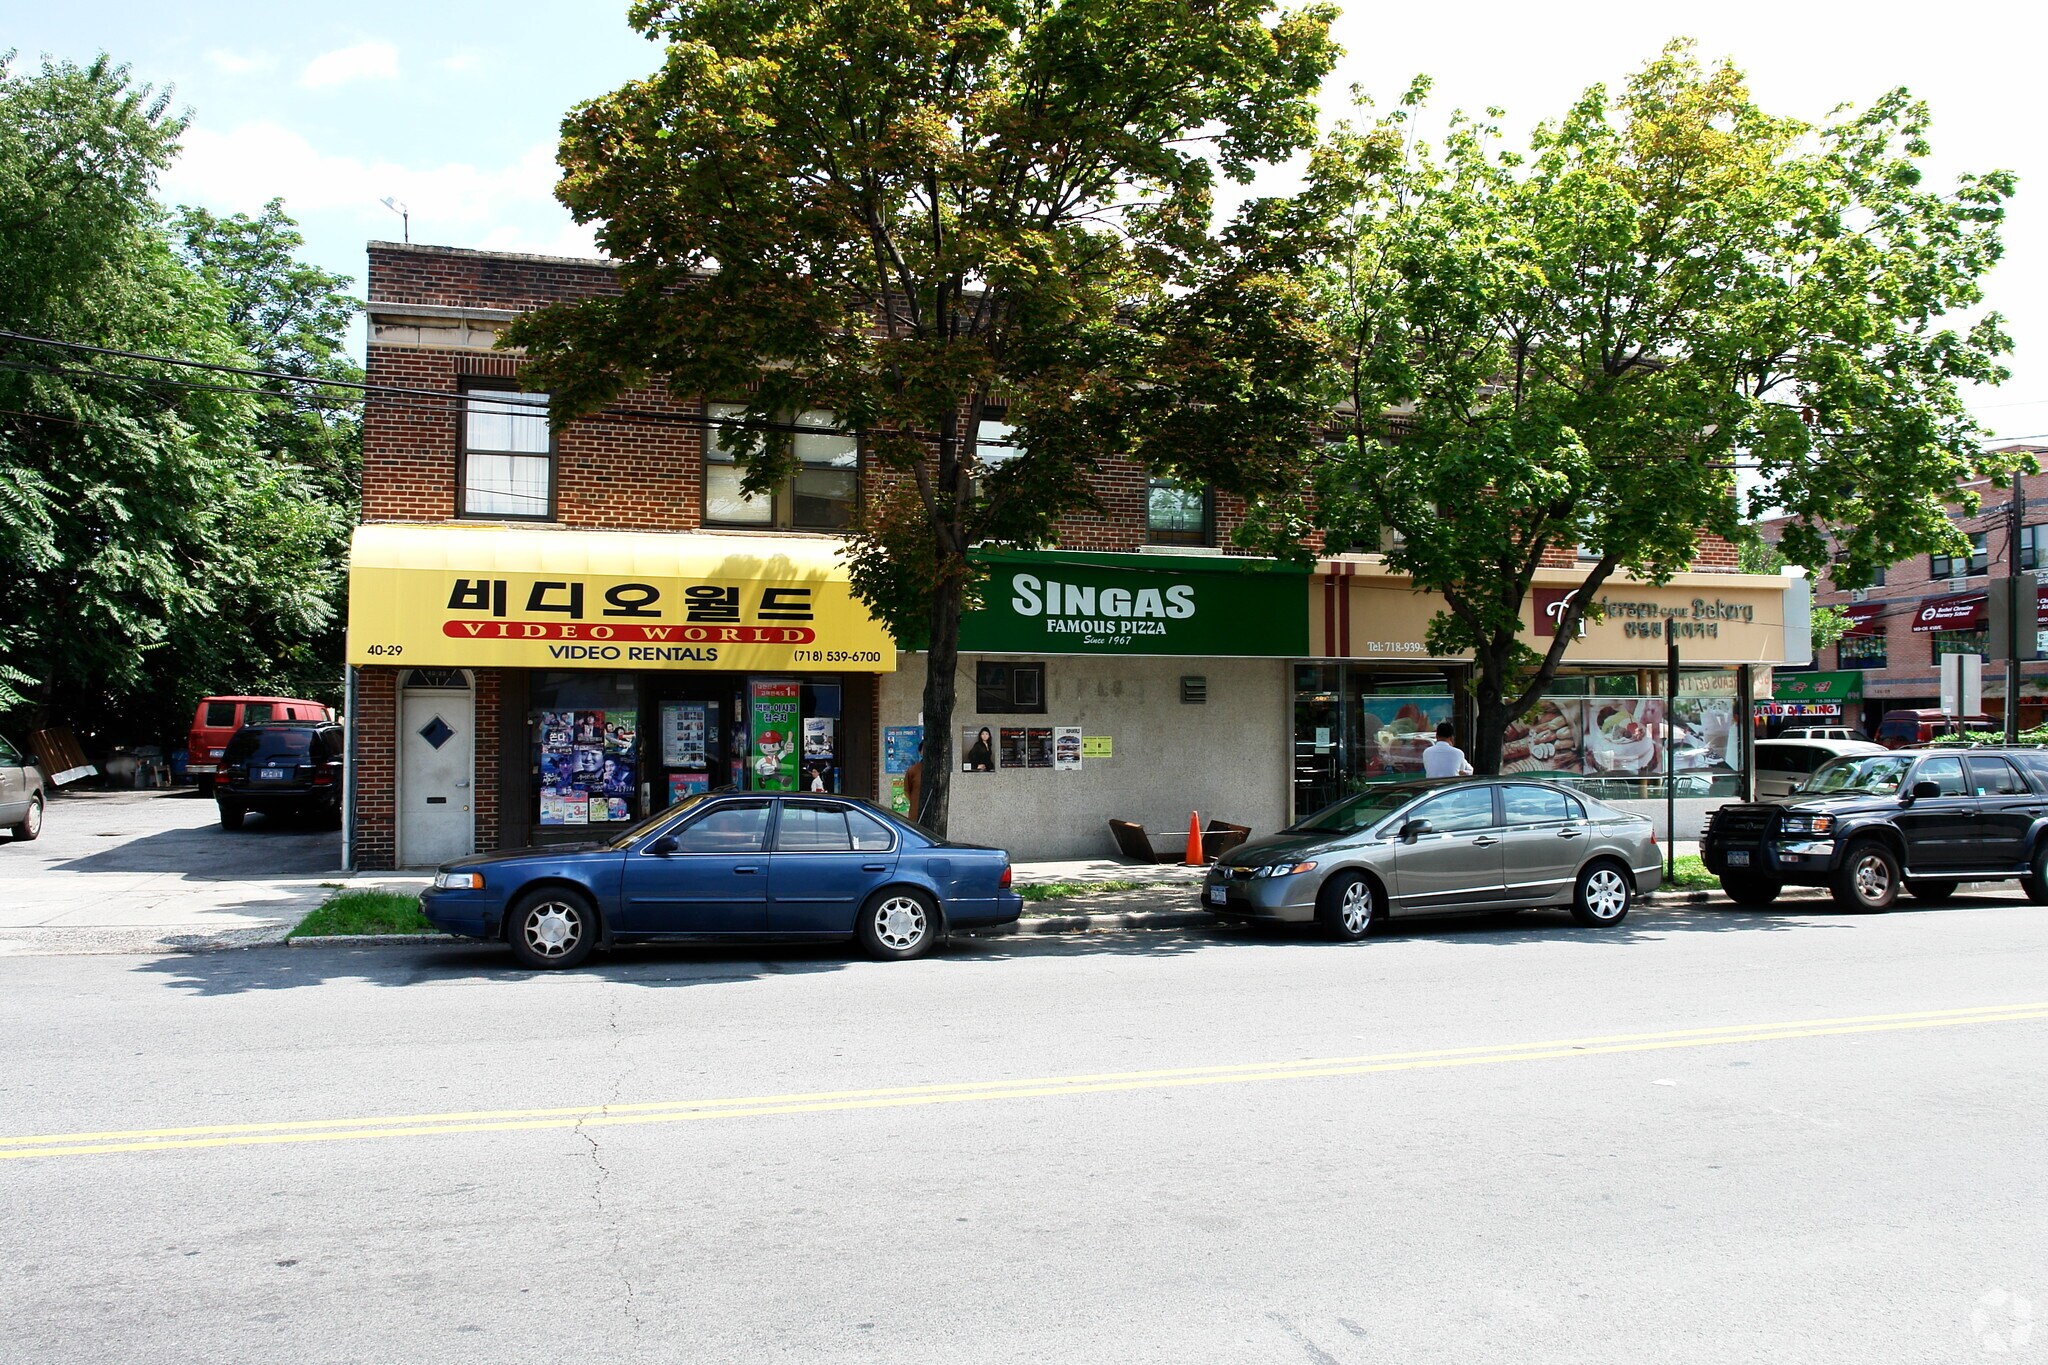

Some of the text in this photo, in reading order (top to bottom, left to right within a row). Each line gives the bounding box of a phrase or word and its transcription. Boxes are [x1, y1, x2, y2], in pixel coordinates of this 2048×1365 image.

[446, 578, 814, 624] 비디오월드
[1012, 573, 1196, 619] SINGAS
[1691, 598, 1754, 623] Bakery
[461, 623, 805, 642] VIDEO WORLD
[1047, 619, 1167, 635] FAMOUS PIZZA
[1083, 635, 1132, 645] Since 1967
[1367, 641, 1384, 652] Tel:
[367, 645, 403, 656] 40-29
[549, 645, 718, 662] VIDEO RENTALS
[794, 650, 881, 662] (718) 539-6700
